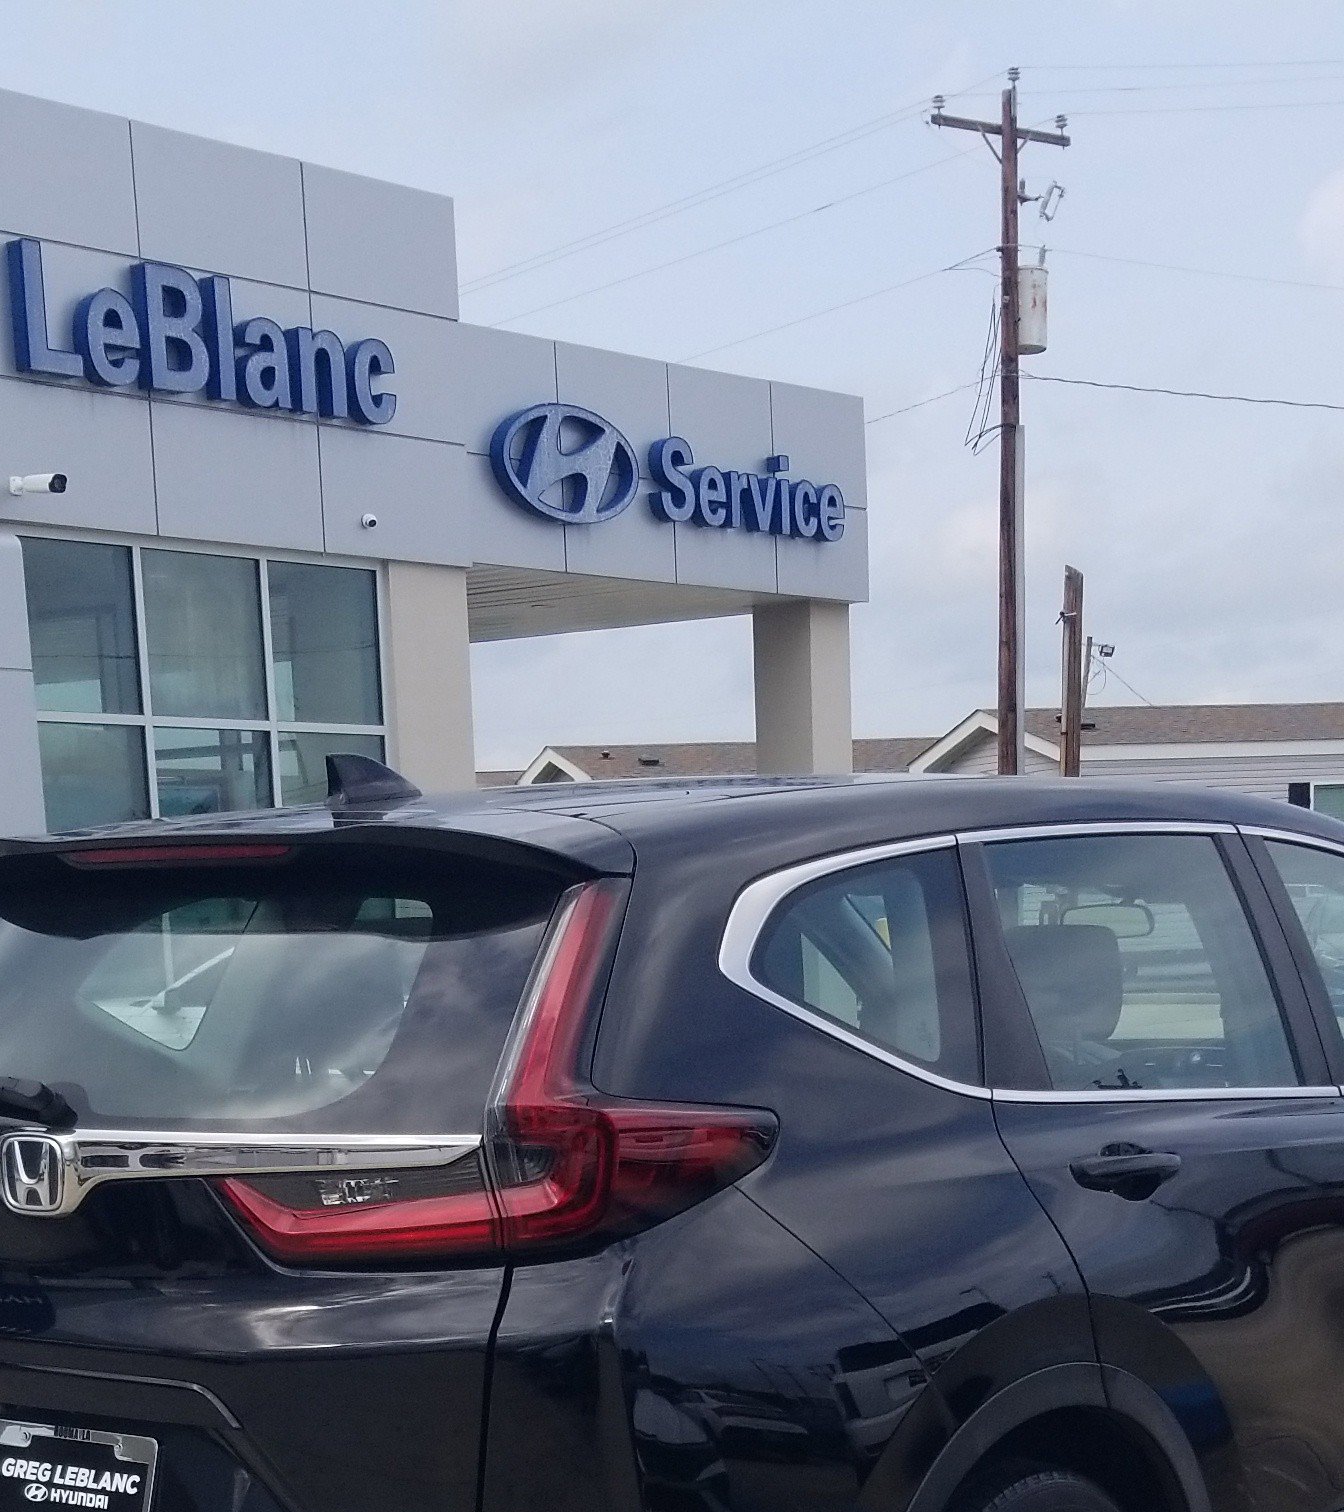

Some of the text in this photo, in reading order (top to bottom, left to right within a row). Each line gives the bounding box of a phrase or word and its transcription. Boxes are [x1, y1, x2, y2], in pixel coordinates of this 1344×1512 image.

[6, 238, 397, 426] LeBlanc
[647, 436, 846, 542] Service
[1, 1457, 141, 1495] GREG LEBLANC
[50, 1487, 109, 1510] HYUNDAI
